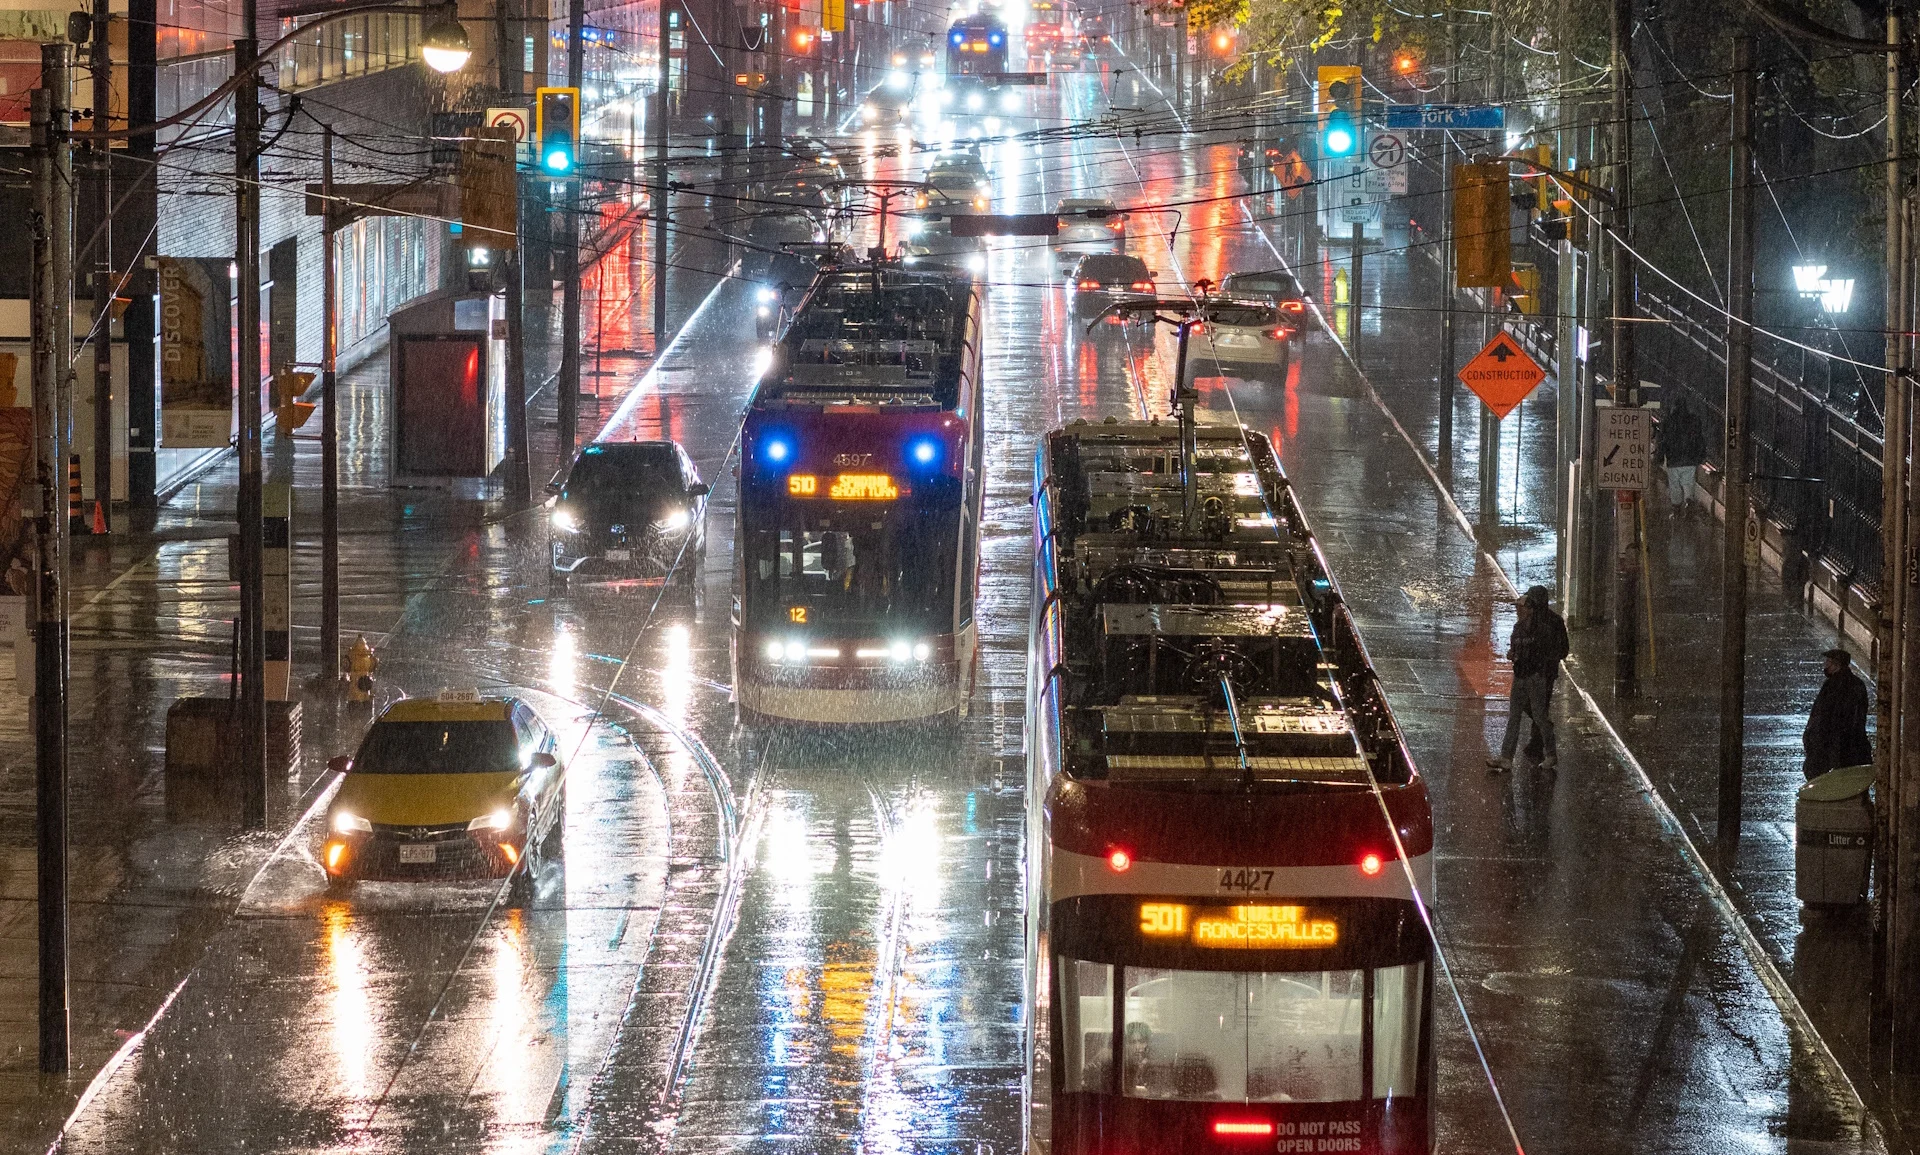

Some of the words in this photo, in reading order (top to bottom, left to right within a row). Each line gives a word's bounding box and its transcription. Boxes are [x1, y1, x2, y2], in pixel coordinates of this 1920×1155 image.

[164, 266, 181, 362] DISCOVER
[1466, 370, 1537, 380] CONSTRUCTION
[1610, 415, 1639, 424] STOP
[1609, 429, 1639, 440] HERE
[1629, 444, 1645, 455] ON
[833, 454, 869, 466] 4597
[1622, 458, 1643, 469] RED
[790, 476, 815, 493] 510
[1603, 473, 1643, 484] SIGNAL
[831, 486, 866, 497] SHORT
[868, 486, 897, 497] TURN
[1910, 546, 1918, 583] T32
[790, 607, 806, 622] 12
[1828, 834, 1850, 845] Litter
[1220, 870, 1274, 891] 4427
[1141, 905, 1182, 931] 501
[1200, 923, 1335, 940] RONCESVALLES
[1276, 1123, 1295, 1136] DO
[1300, 1122, 1326, 1135] NOT
[1329, 1121, 1361, 1134] PASS
[1277, 1139, 1314, 1153] OPEN
[1318, 1138, 1361, 1152] DOORS
